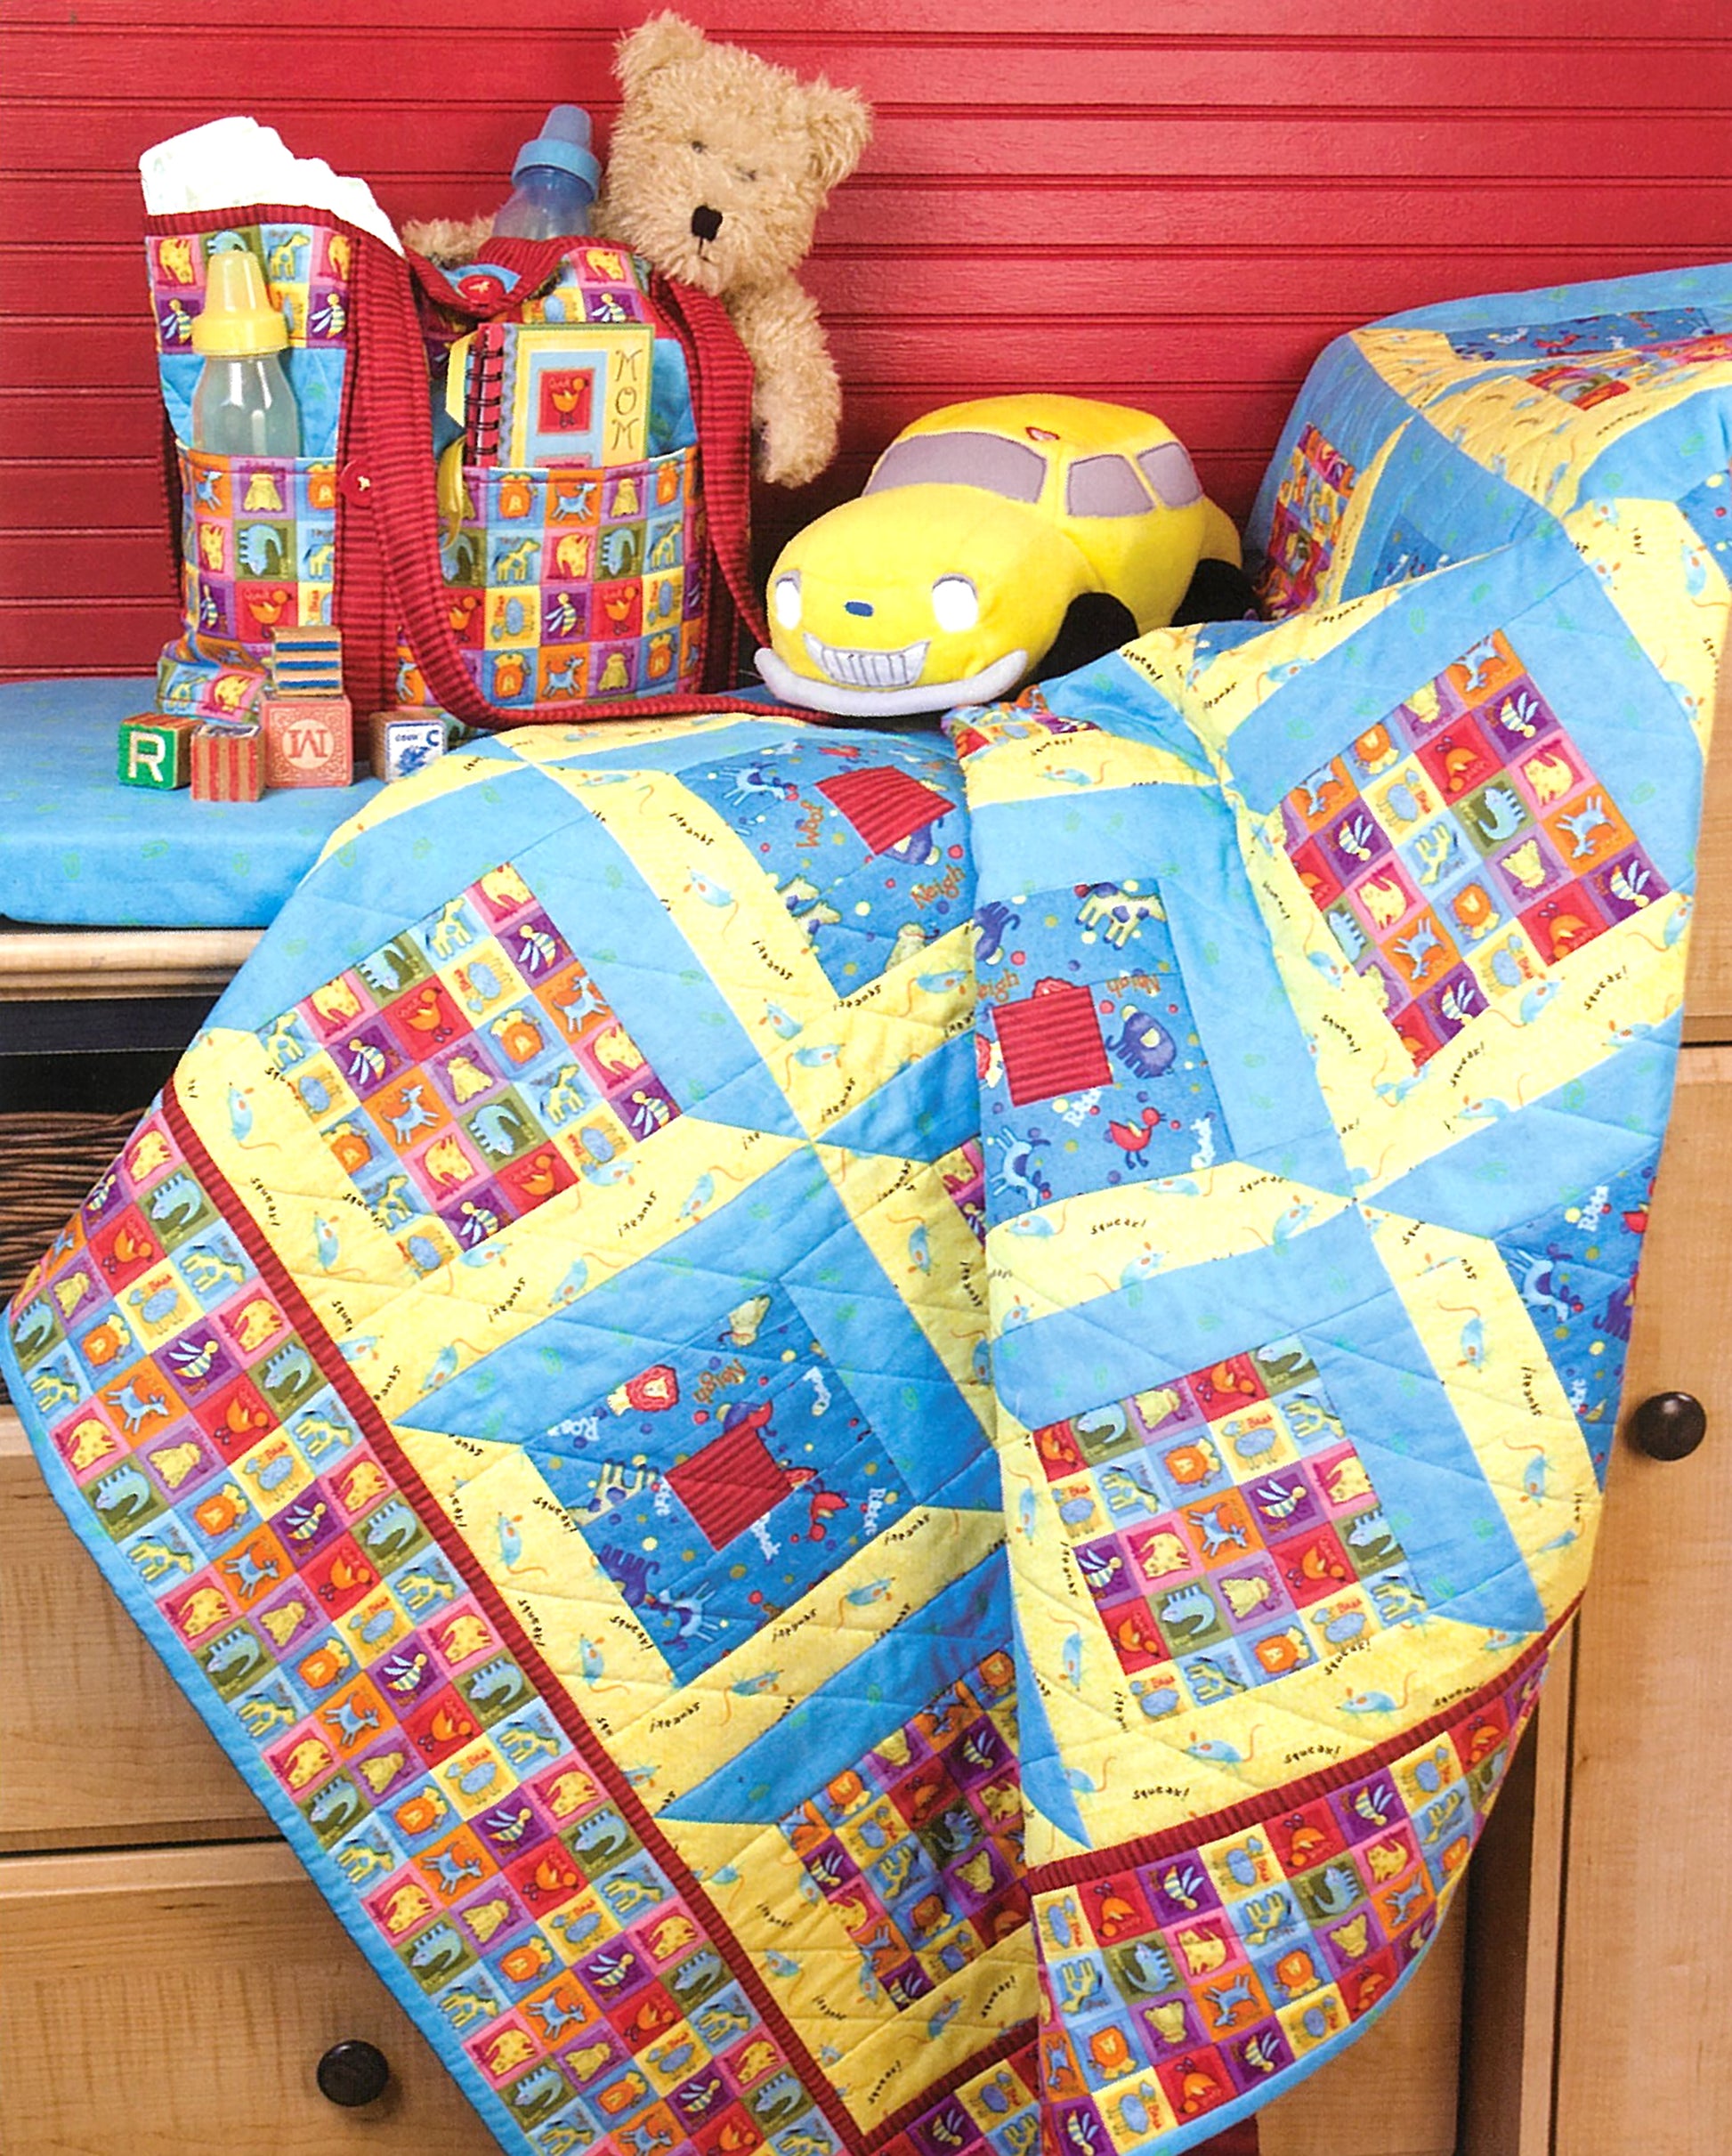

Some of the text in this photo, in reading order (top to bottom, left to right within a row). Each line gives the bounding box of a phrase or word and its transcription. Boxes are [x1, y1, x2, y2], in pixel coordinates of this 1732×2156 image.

[611, 348, 646, 451] MOM
[128, 730, 166, 783] R
[287, 729, 328, 758] M
[426, 730, 440, 747] C
[669, 811, 716, 847] squeak!
[797, 799, 826, 850] Woof
[911, 865, 967, 911] Neigh
[751, 939, 793, 981] squeak!
[1584, 965, 1629, 1012] squeak!
[1322, 1015, 1361, 1055] squeak!
[1449, 1041, 1486, 1088] squeak!
[822, 1077, 856, 1122] squeak!
[249, 1178, 281, 1227] squeak!
[617, 1190, 656, 1236] squeak!
[1089, 1219, 1146, 1235] squeak!
[489, 1277, 525, 1322] squeak!
[692, 1358, 748, 1406] Neigh
[1521, 1366, 1542, 1417] squeak!
[531, 1496, 579, 1534] squeak!
[518, 1599, 546, 1647] squeak!
[610, 1616, 653, 1650] squeak!
[1323, 1640, 1372, 1676] squeak!
[649, 1701, 701, 1732] squeak!
[1283, 1743, 1342, 1764] squeak!
[1132, 1786, 1191, 1801] squeak!
